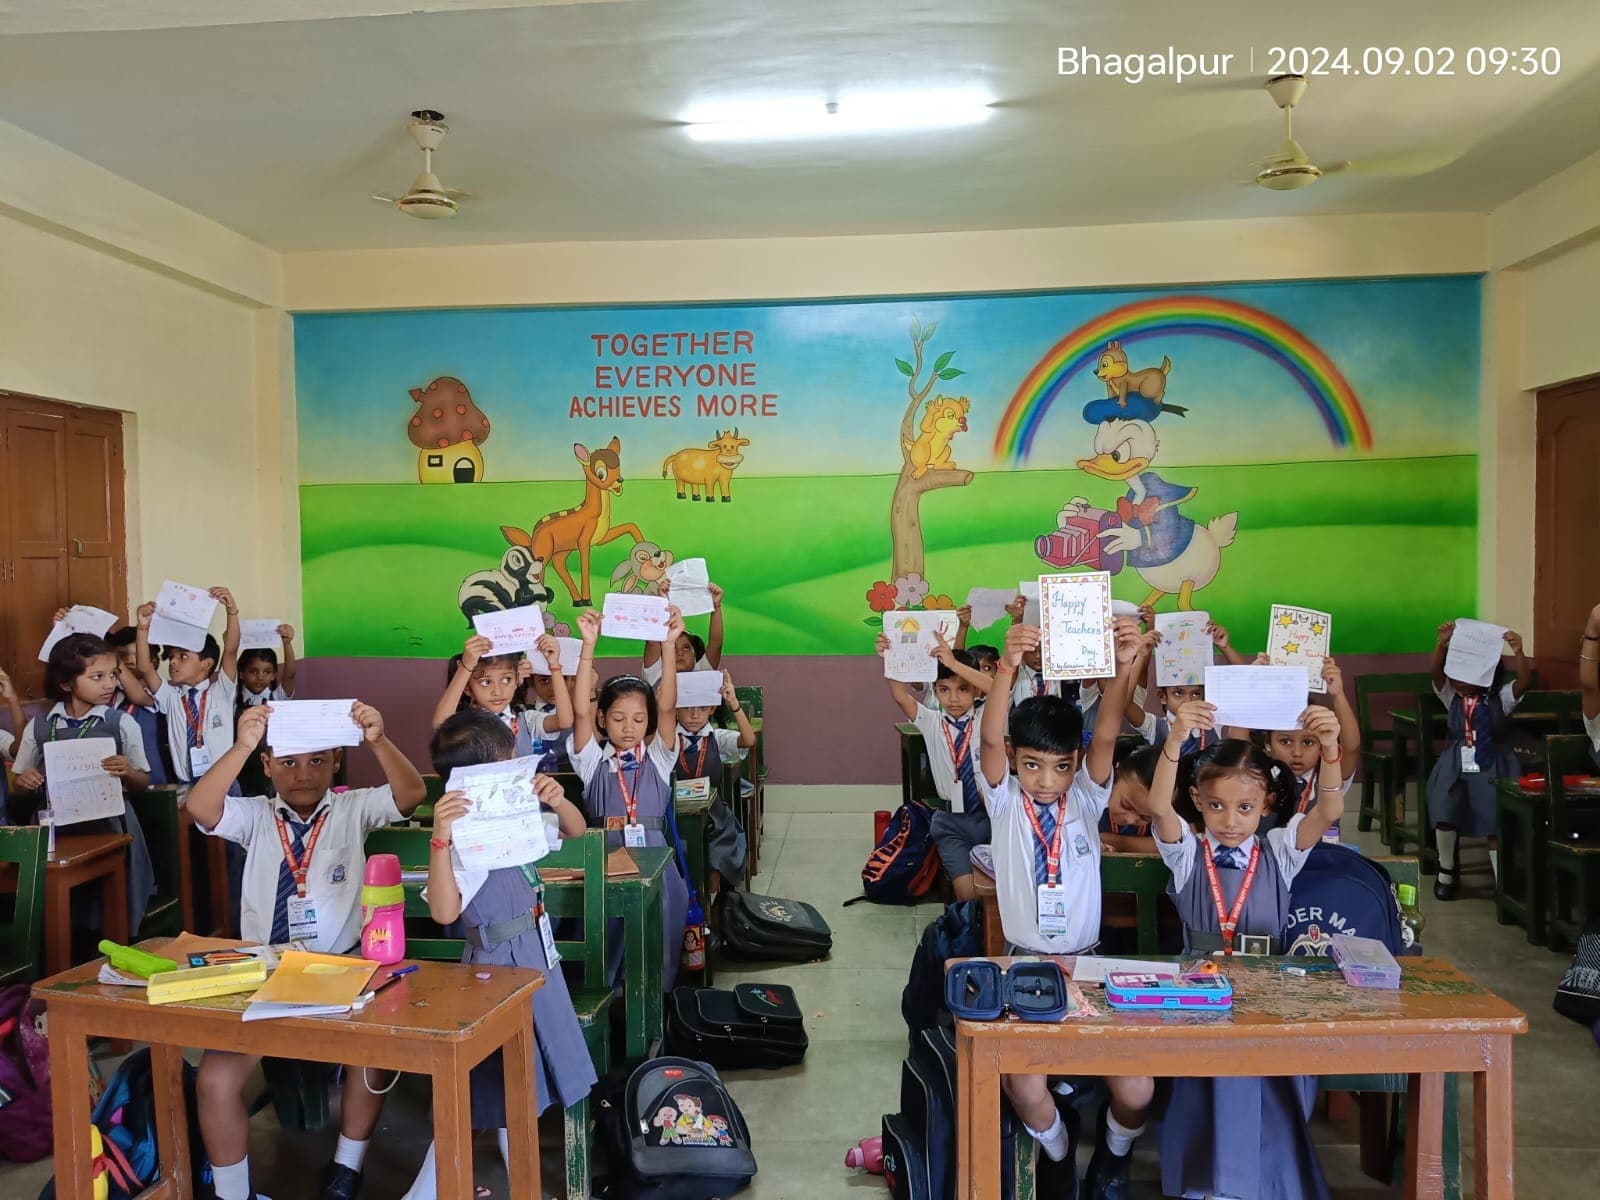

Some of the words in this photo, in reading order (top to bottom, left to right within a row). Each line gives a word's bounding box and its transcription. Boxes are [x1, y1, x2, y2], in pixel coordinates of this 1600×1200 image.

[591, 331, 754, 357] TOGETHER
[595, 363, 756, 389] EVERYONE
[569, 395, 681, 418] ACHIEVES
[697, 394, 778, 417] MORE
[1051, 590, 1087, 616] Happy
[1287, 906, 1324, 929] DER
